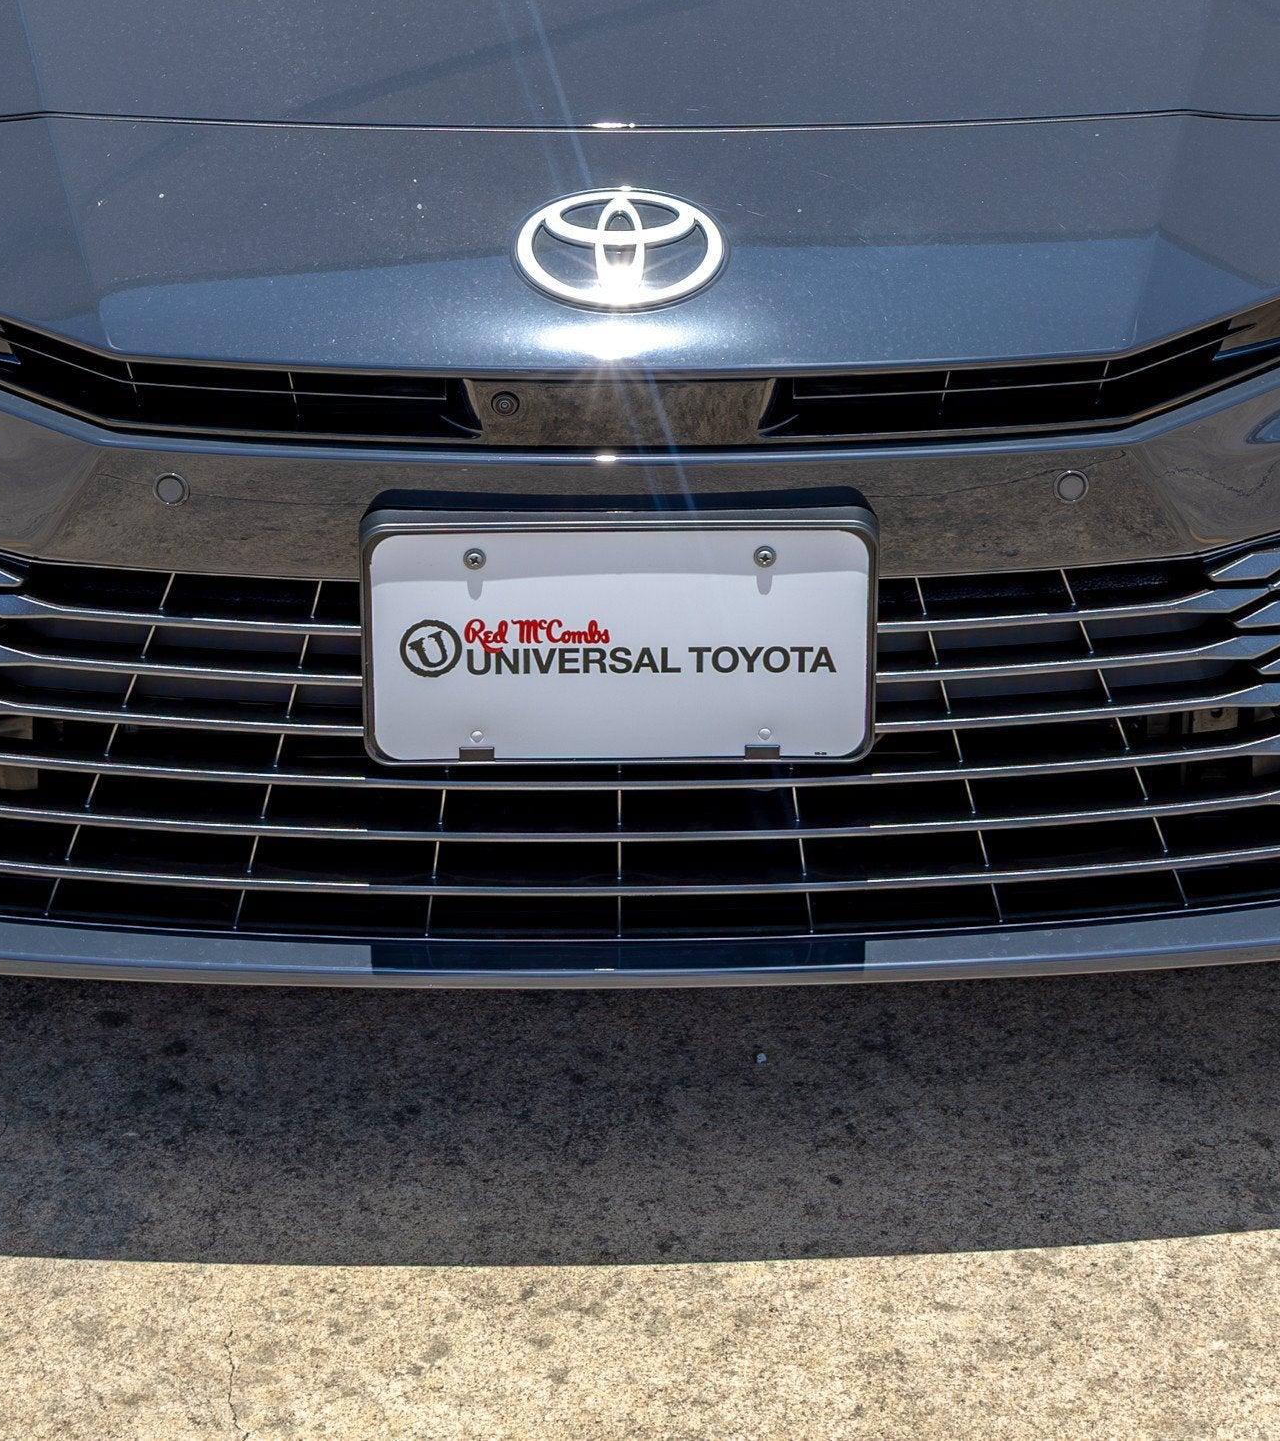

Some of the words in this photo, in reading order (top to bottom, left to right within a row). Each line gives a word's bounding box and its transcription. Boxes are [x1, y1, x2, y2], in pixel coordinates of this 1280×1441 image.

[464, 618, 509, 654] Red
[511, 619, 610, 645] McCombs
[466, 647, 681, 676] UNIVERSAL
[688, 646, 837, 674] TOYOTA
